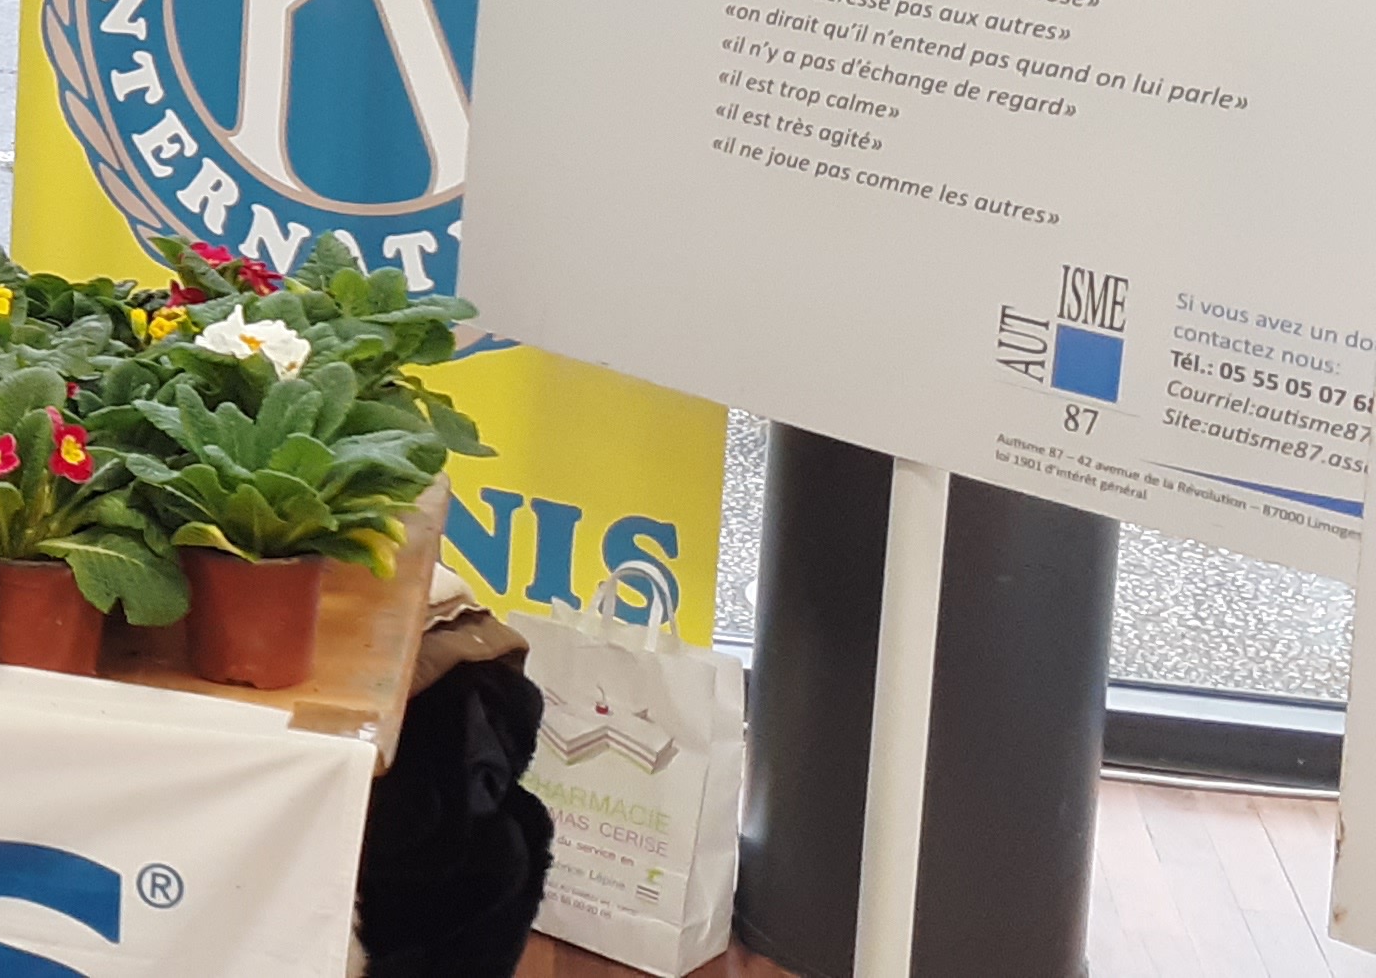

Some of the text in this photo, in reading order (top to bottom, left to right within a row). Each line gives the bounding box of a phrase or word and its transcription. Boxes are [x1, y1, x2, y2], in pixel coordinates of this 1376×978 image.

[938, 6, 980, 27] aux
[984, 13, 1072, 41] autres»
[765, 8, 820, 34] dirait
[969, 48, 1011, 70] pas
[1015, 56, 1091, 84] quand
[1095, 71, 1126, 91] on
[1132, 73, 1165, 97] lui
[1167, 83, 1249, 112] parle»
[783, 50, 796, 64] a
[799, 53, 836, 73] pas
[953, 79, 981, 103] de
[986, 87, 1077, 118] regard»
[745, 76, 775, 95] est
[779, 80, 821, 107] trop
[825, 94, 900, 119] calme»
[742, 109, 771, 129] est
[776, 114, 814, 138] très
[818, 127, 884, 152] agité»
[739, 142, 764, 161] ne
[765, 146, 811, 173] joue
[814, 160, 852, 181] pas
[855, 170, 934, 199] comme
[938, 183, 969, 208] les
[974, 195, 1060, 225] autres»
[1056, 264, 1129, 333] ISME
[1176, 292, 1376, 353] Si vous avez un do
[995, 305, 1049, 384] AUT
[1174, 326, 1341, 375] contactez nous:
[1219, 362, 1246, 383] 05
[1252, 370, 1279, 391] 55
[1285, 377, 1312, 399] 05
[1318, 385, 1347, 407] 07
[1063, 403, 1099, 436] 87
[1162, 407, 1370, 474] Site:autisme87.ass
[995, 450, 1010, 463] loi
[1013, 455, 1042, 472] 1901
[1099, 480, 1147, 500] général
[996, 433, 1046, 455] Autisme
[1048, 446, 1064, 460] 87
[1095, 462, 1140, 480] avenue
[1143, 472, 1160, 487] de
[1163, 477, 1174, 490] la
[1177, 481, 1247, 510] Révolution
[1262, 504, 1305, 525] 87000
[599, 822, 669, 858] CERISE
